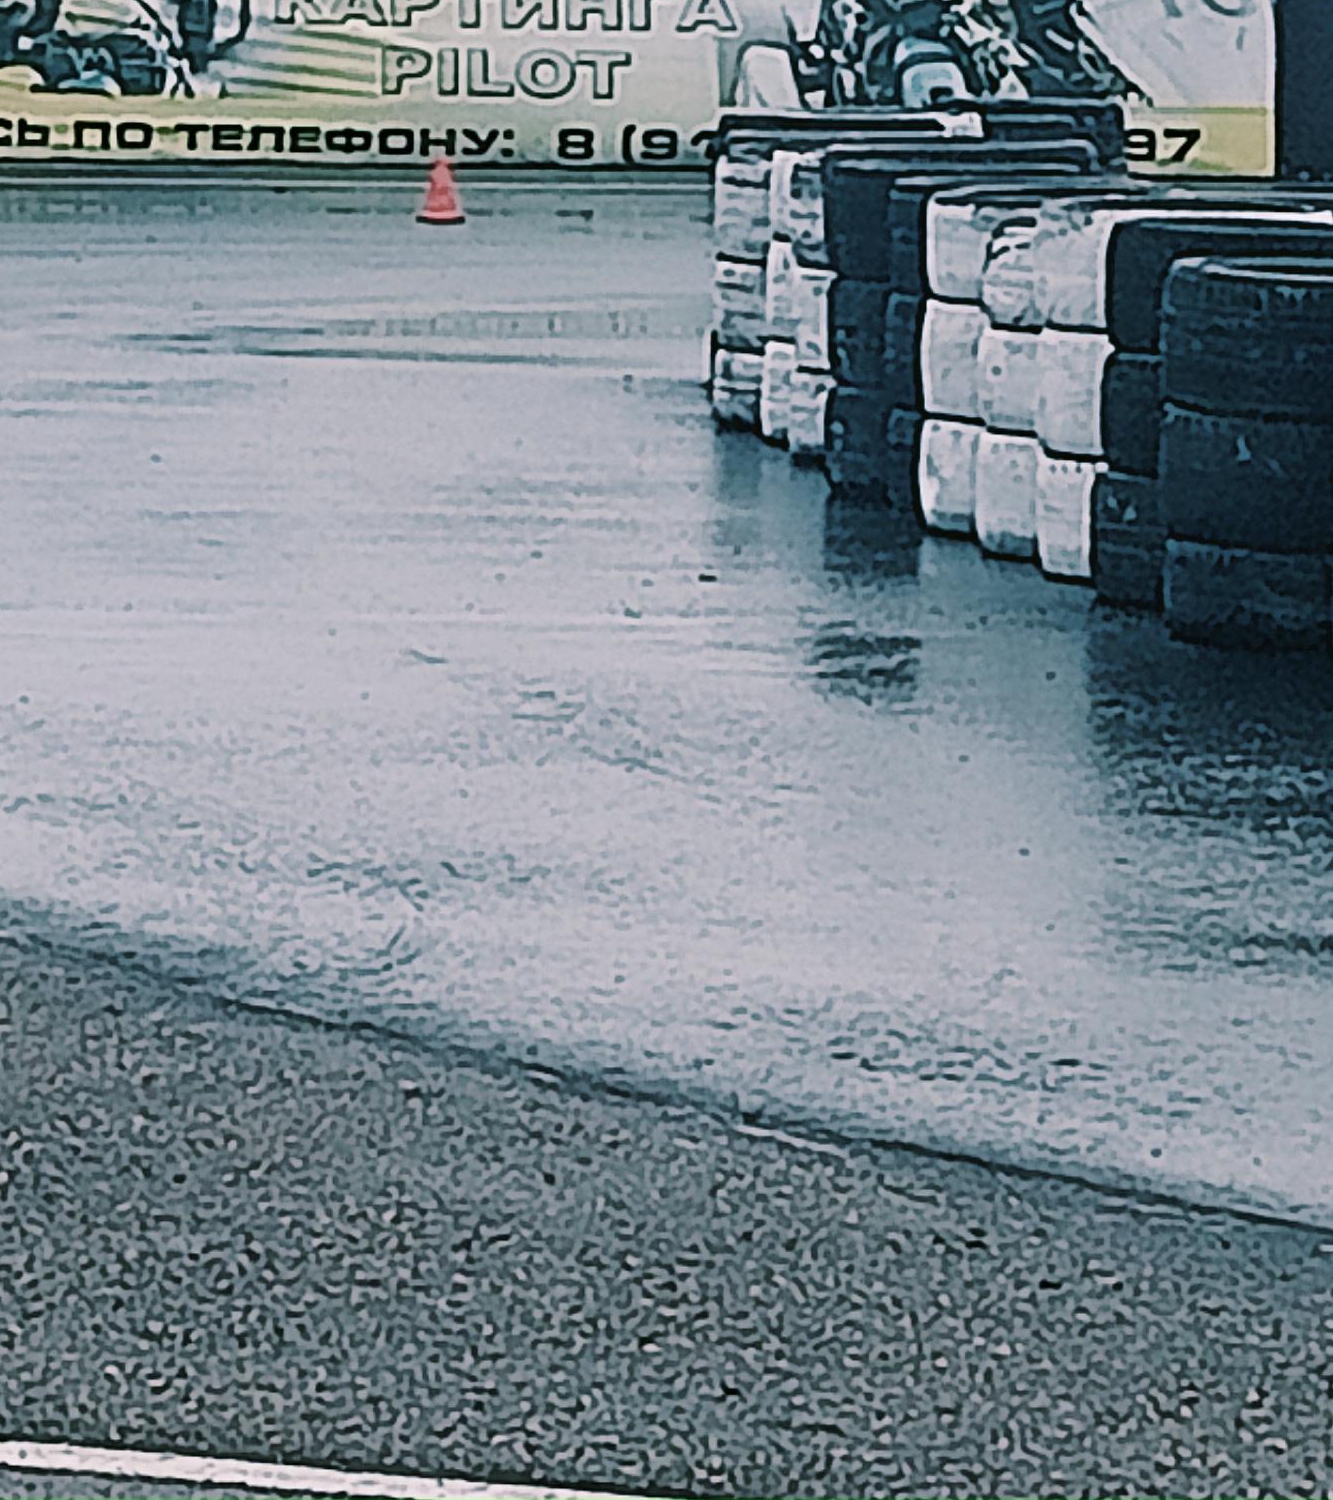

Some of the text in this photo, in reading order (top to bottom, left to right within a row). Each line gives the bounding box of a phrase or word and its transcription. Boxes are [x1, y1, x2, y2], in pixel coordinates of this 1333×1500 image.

[381, 46, 632, 100] PILOT
[72, 120, 154, 150] ПО
[174, 124, 516, 157] ТЕЛЕФОНУ:
[557, 128, 595, 160] 8
